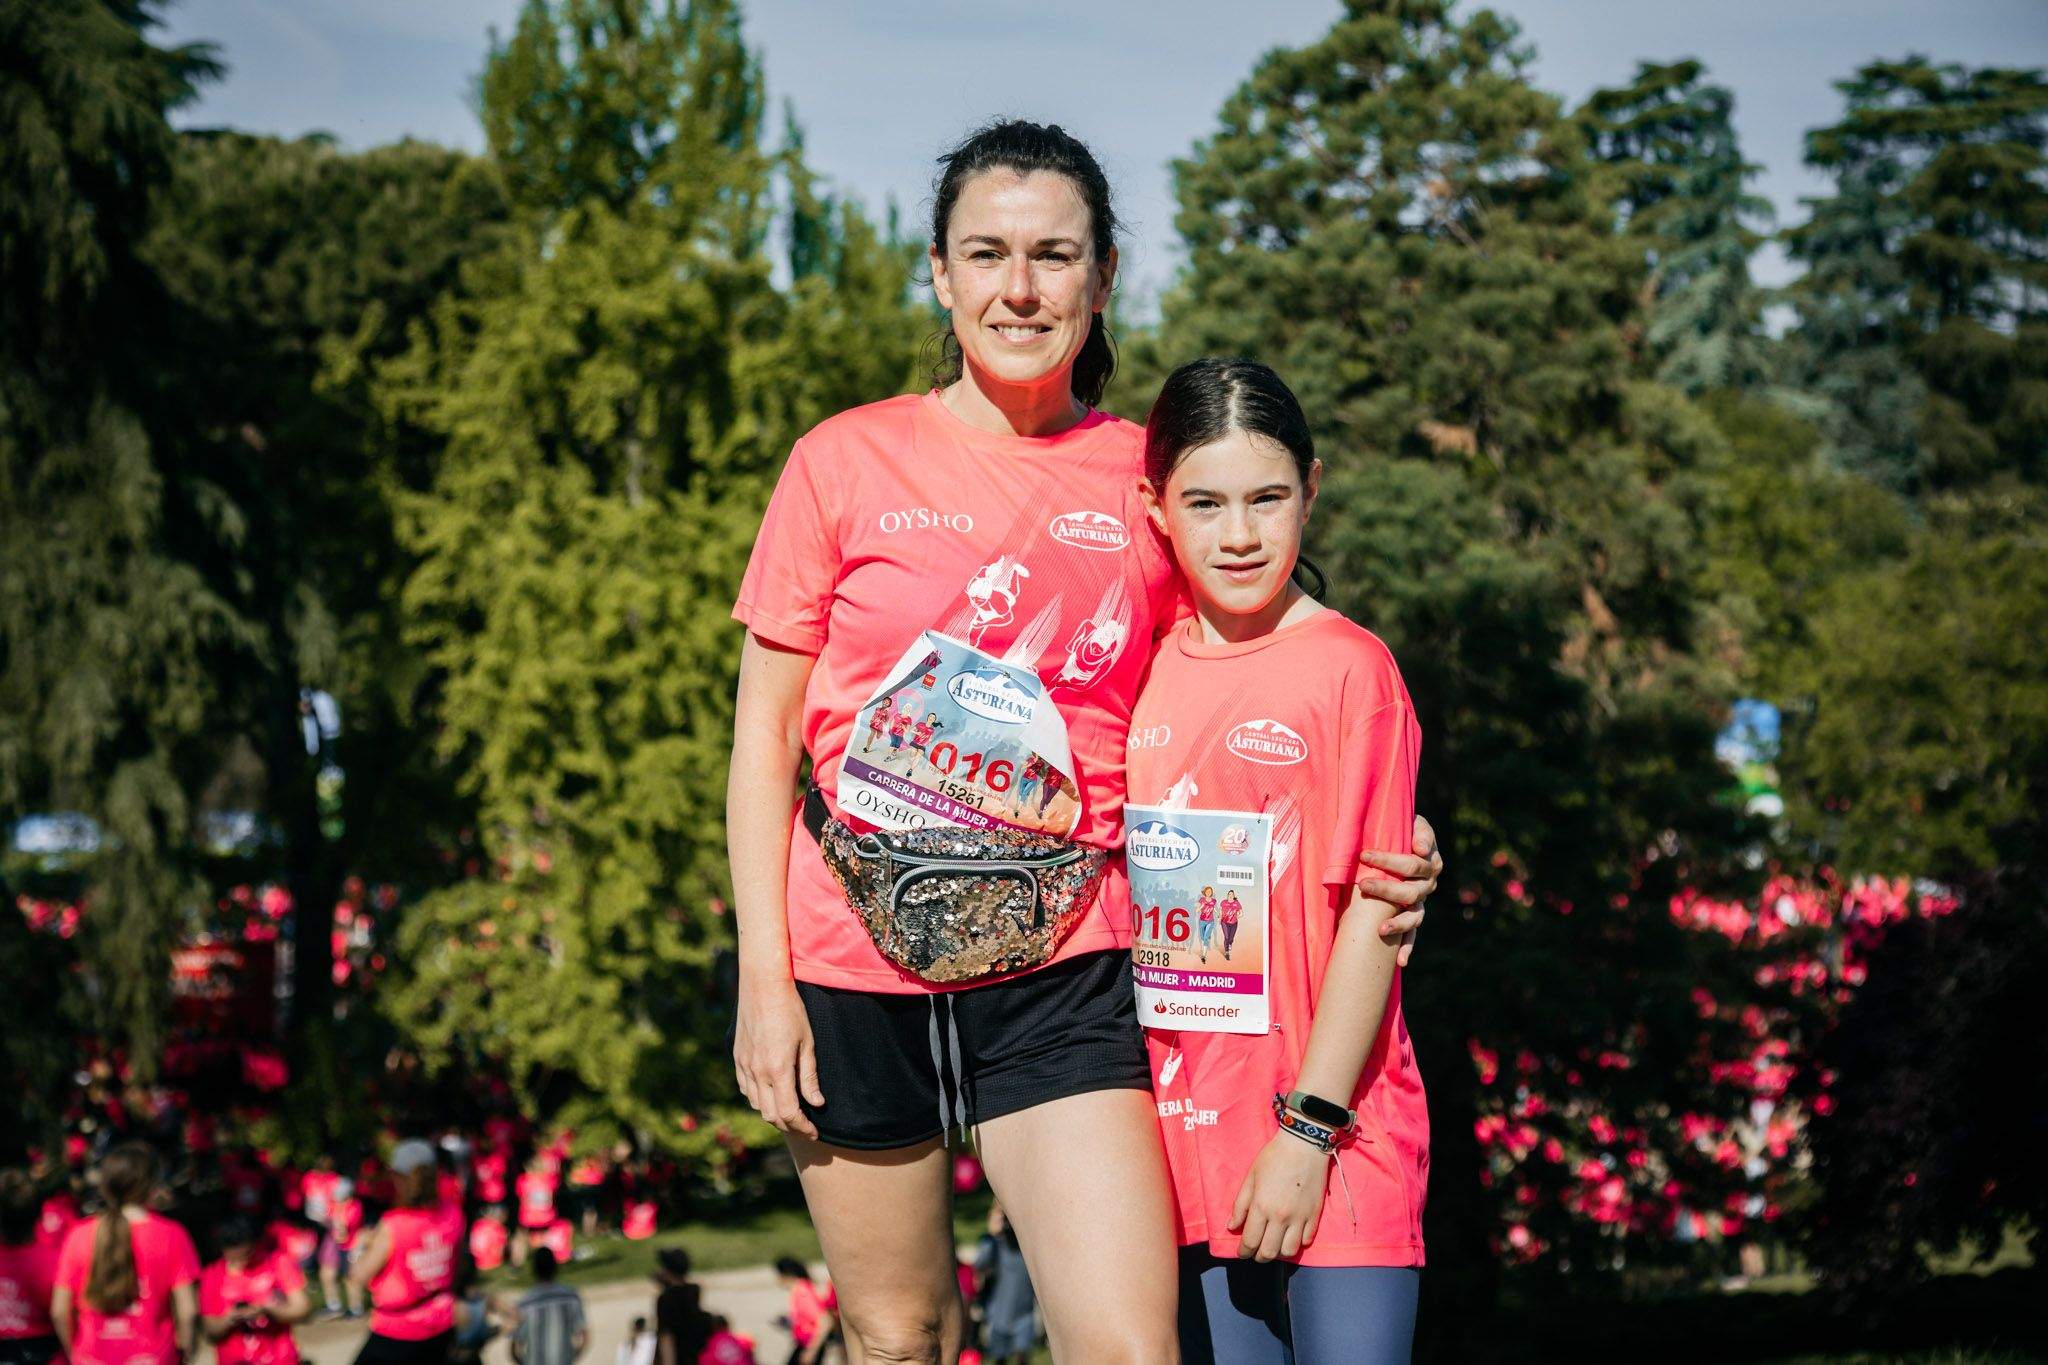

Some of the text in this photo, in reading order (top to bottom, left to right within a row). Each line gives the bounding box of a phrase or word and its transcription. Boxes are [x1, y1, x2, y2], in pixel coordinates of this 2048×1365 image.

[879, 508, 974, 533] OYSHO
[1056, 521, 1125, 545] ASTURIANA
[952, 677, 1033, 720] ASTURIANA
[1231, 731, 1300, 759] ASTURIANA
[929, 741, 1015, 792] 016
[856, 789, 926, 829] OYSHO
[868, 771, 916, 800] CARRERA
[919, 792, 935, 806] DE
[936, 797, 950, 812] LA
[952, 806, 989, 829] MUJER
[1129, 835, 1192, 861] ASTURIANA
[1148, 971, 1179, 985] MUJER
[1188, 975, 1236, 988] MADRID
[1169, 1002, 1240, 1018] Santander
